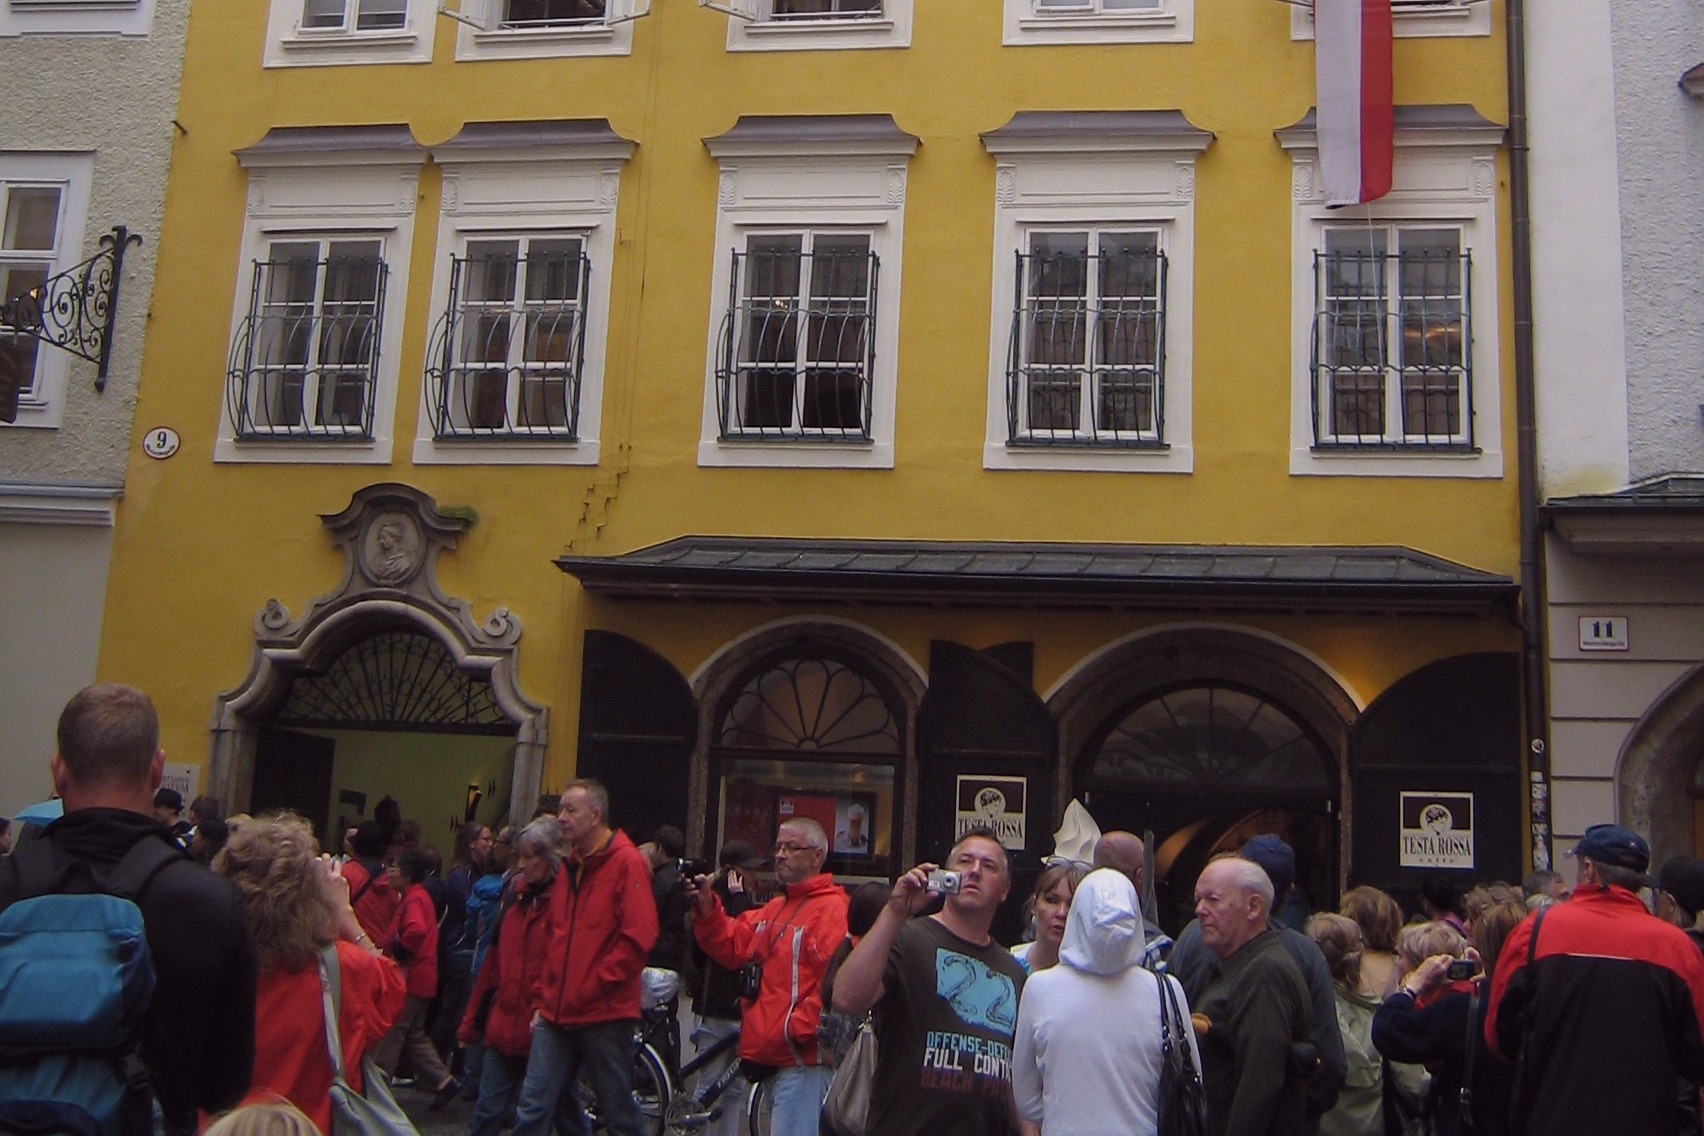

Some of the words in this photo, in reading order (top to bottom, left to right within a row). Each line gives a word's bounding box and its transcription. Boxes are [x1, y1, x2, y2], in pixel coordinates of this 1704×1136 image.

[156, 431, 167, 449] 9
[1592, 621, 1613, 638] 11
[1403, 836, 1435, 855] TESTA
[1438, 837, 1471, 856] ROSSA
[923, 1047, 963, 1071] FULL
